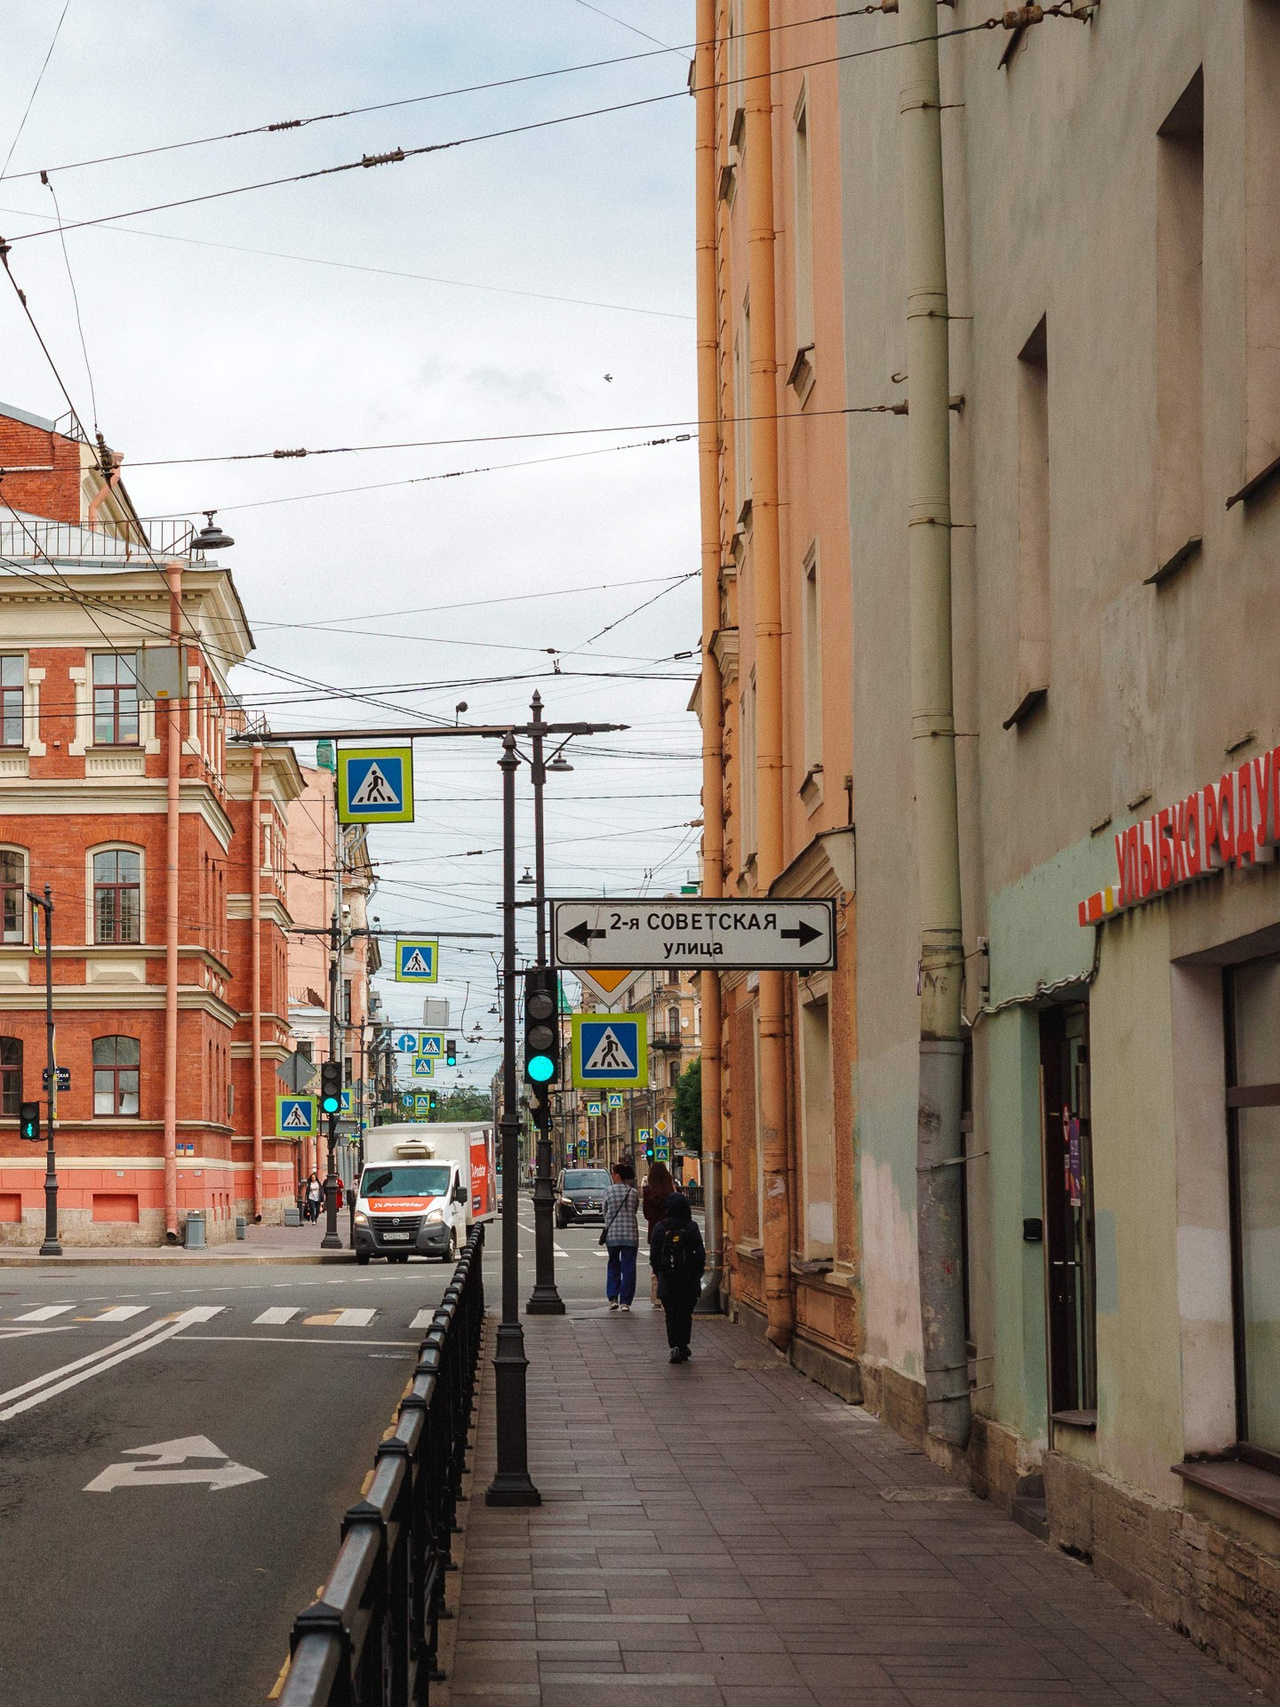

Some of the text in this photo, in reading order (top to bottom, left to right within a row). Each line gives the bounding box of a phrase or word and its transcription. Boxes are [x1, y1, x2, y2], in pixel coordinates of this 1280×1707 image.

[610, 912, 778, 931] 2-я СОВЕТСКАЯ
[663, 942, 724, 959] улица
